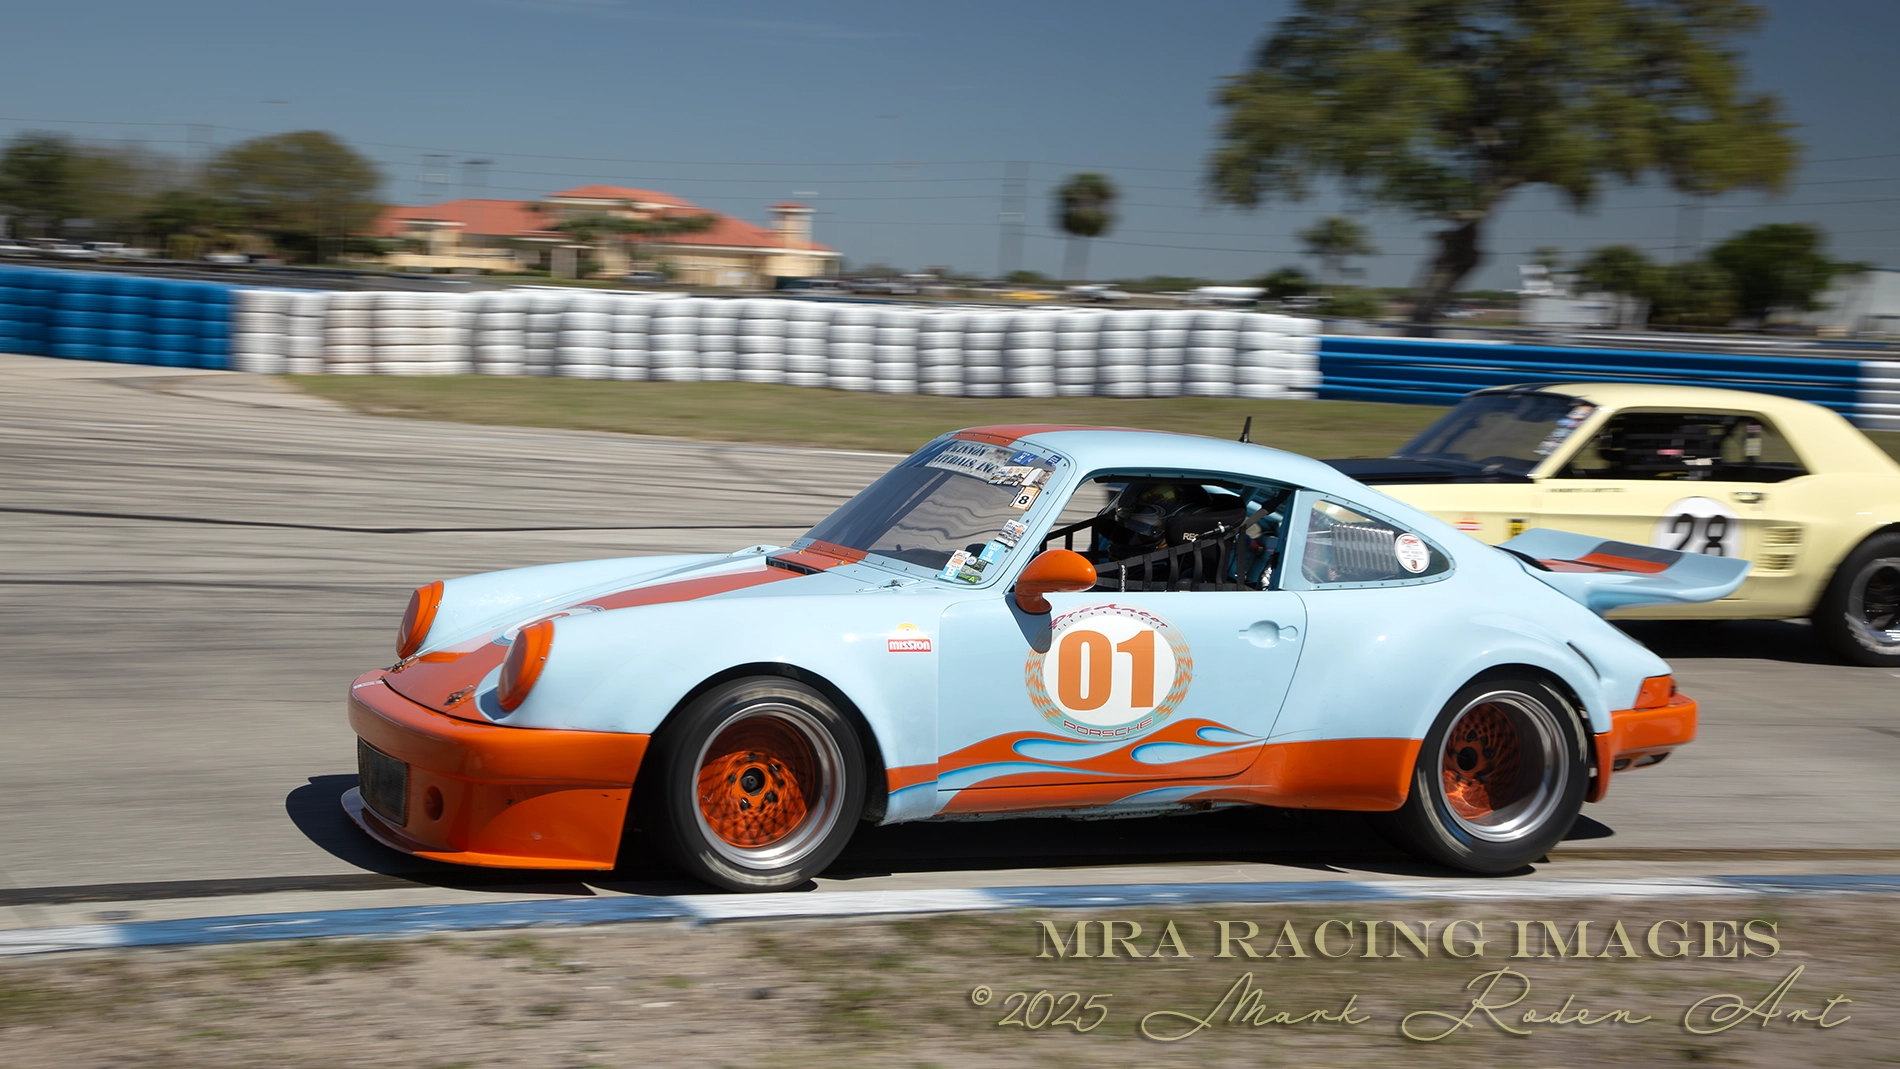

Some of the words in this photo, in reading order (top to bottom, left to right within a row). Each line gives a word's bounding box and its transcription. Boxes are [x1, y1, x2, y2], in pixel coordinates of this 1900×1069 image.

[1018, 495, 1030, 505] 8
[1670, 513, 1728, 557] 28
[946, 567, 956, 577] B
[1058, 630, 1154, 711] 01
[1063, 717, 1153, 737] PORSCHE
